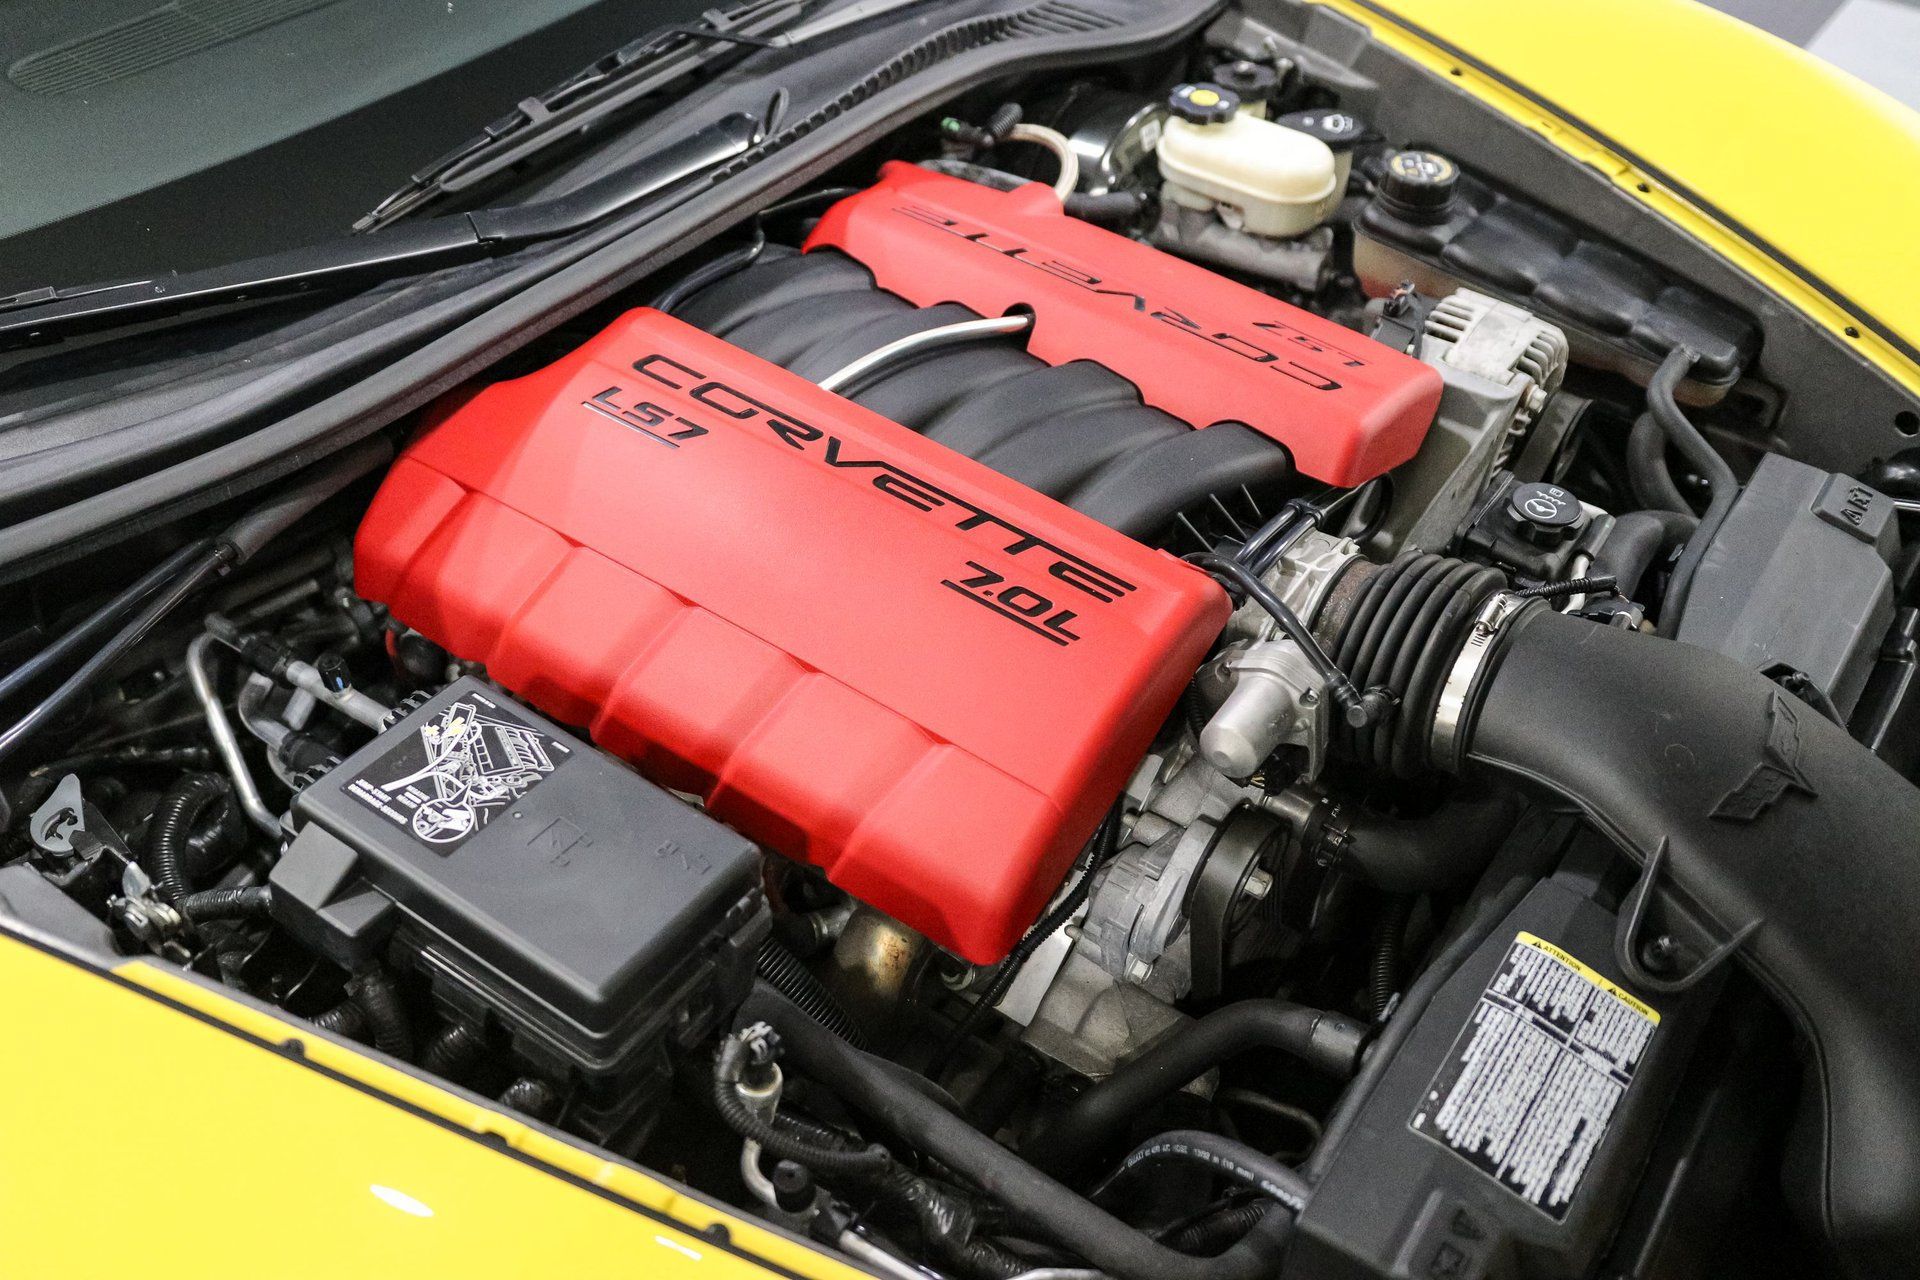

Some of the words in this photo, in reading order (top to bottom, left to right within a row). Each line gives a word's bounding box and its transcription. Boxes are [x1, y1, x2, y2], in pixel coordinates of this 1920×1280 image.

[892, 205, 1343, 391] CORVETTE
[590, 385, 710, 442] LS7
[633, 353, 1138, 603] CORVETTE
[958, 560, 1080, 642] 7.0L
[1543, 945, 1582, 972] ATTENTION
[1618, 992, 1650, 1016] CAUTION
